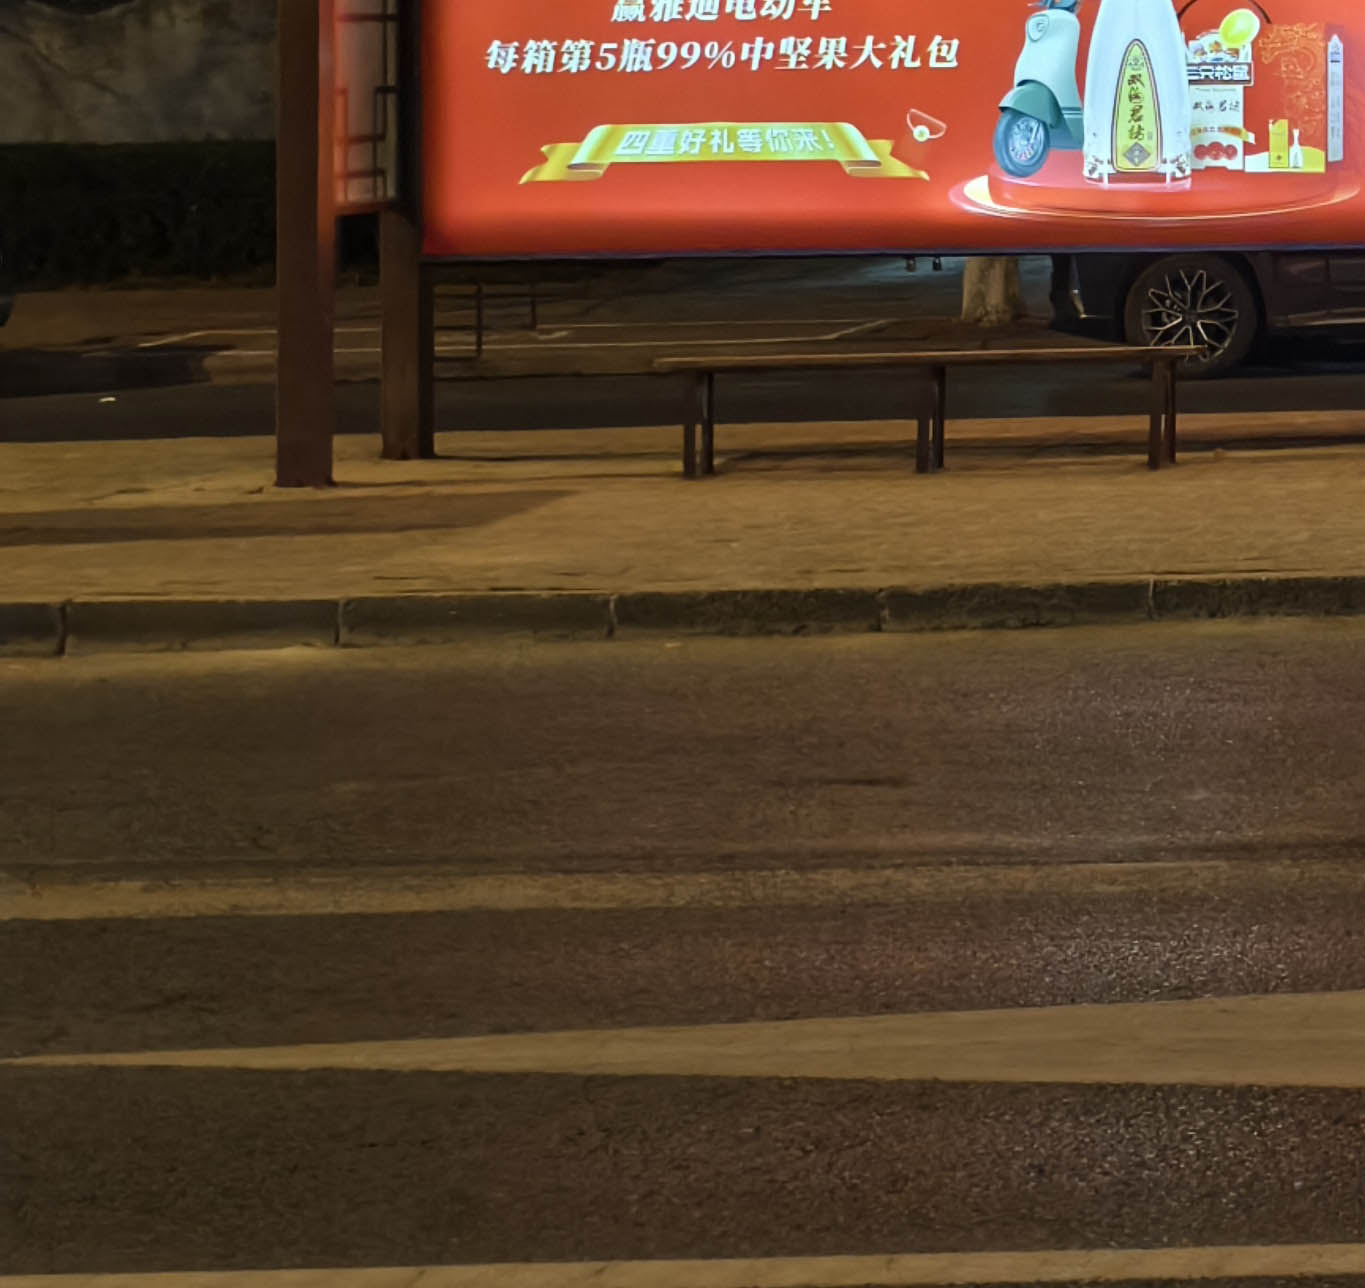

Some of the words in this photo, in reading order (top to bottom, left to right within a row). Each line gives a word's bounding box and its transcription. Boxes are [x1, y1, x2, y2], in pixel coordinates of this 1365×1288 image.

[484, 34, 960, 74] 每箱第5瓶99%中坚果大礼包
